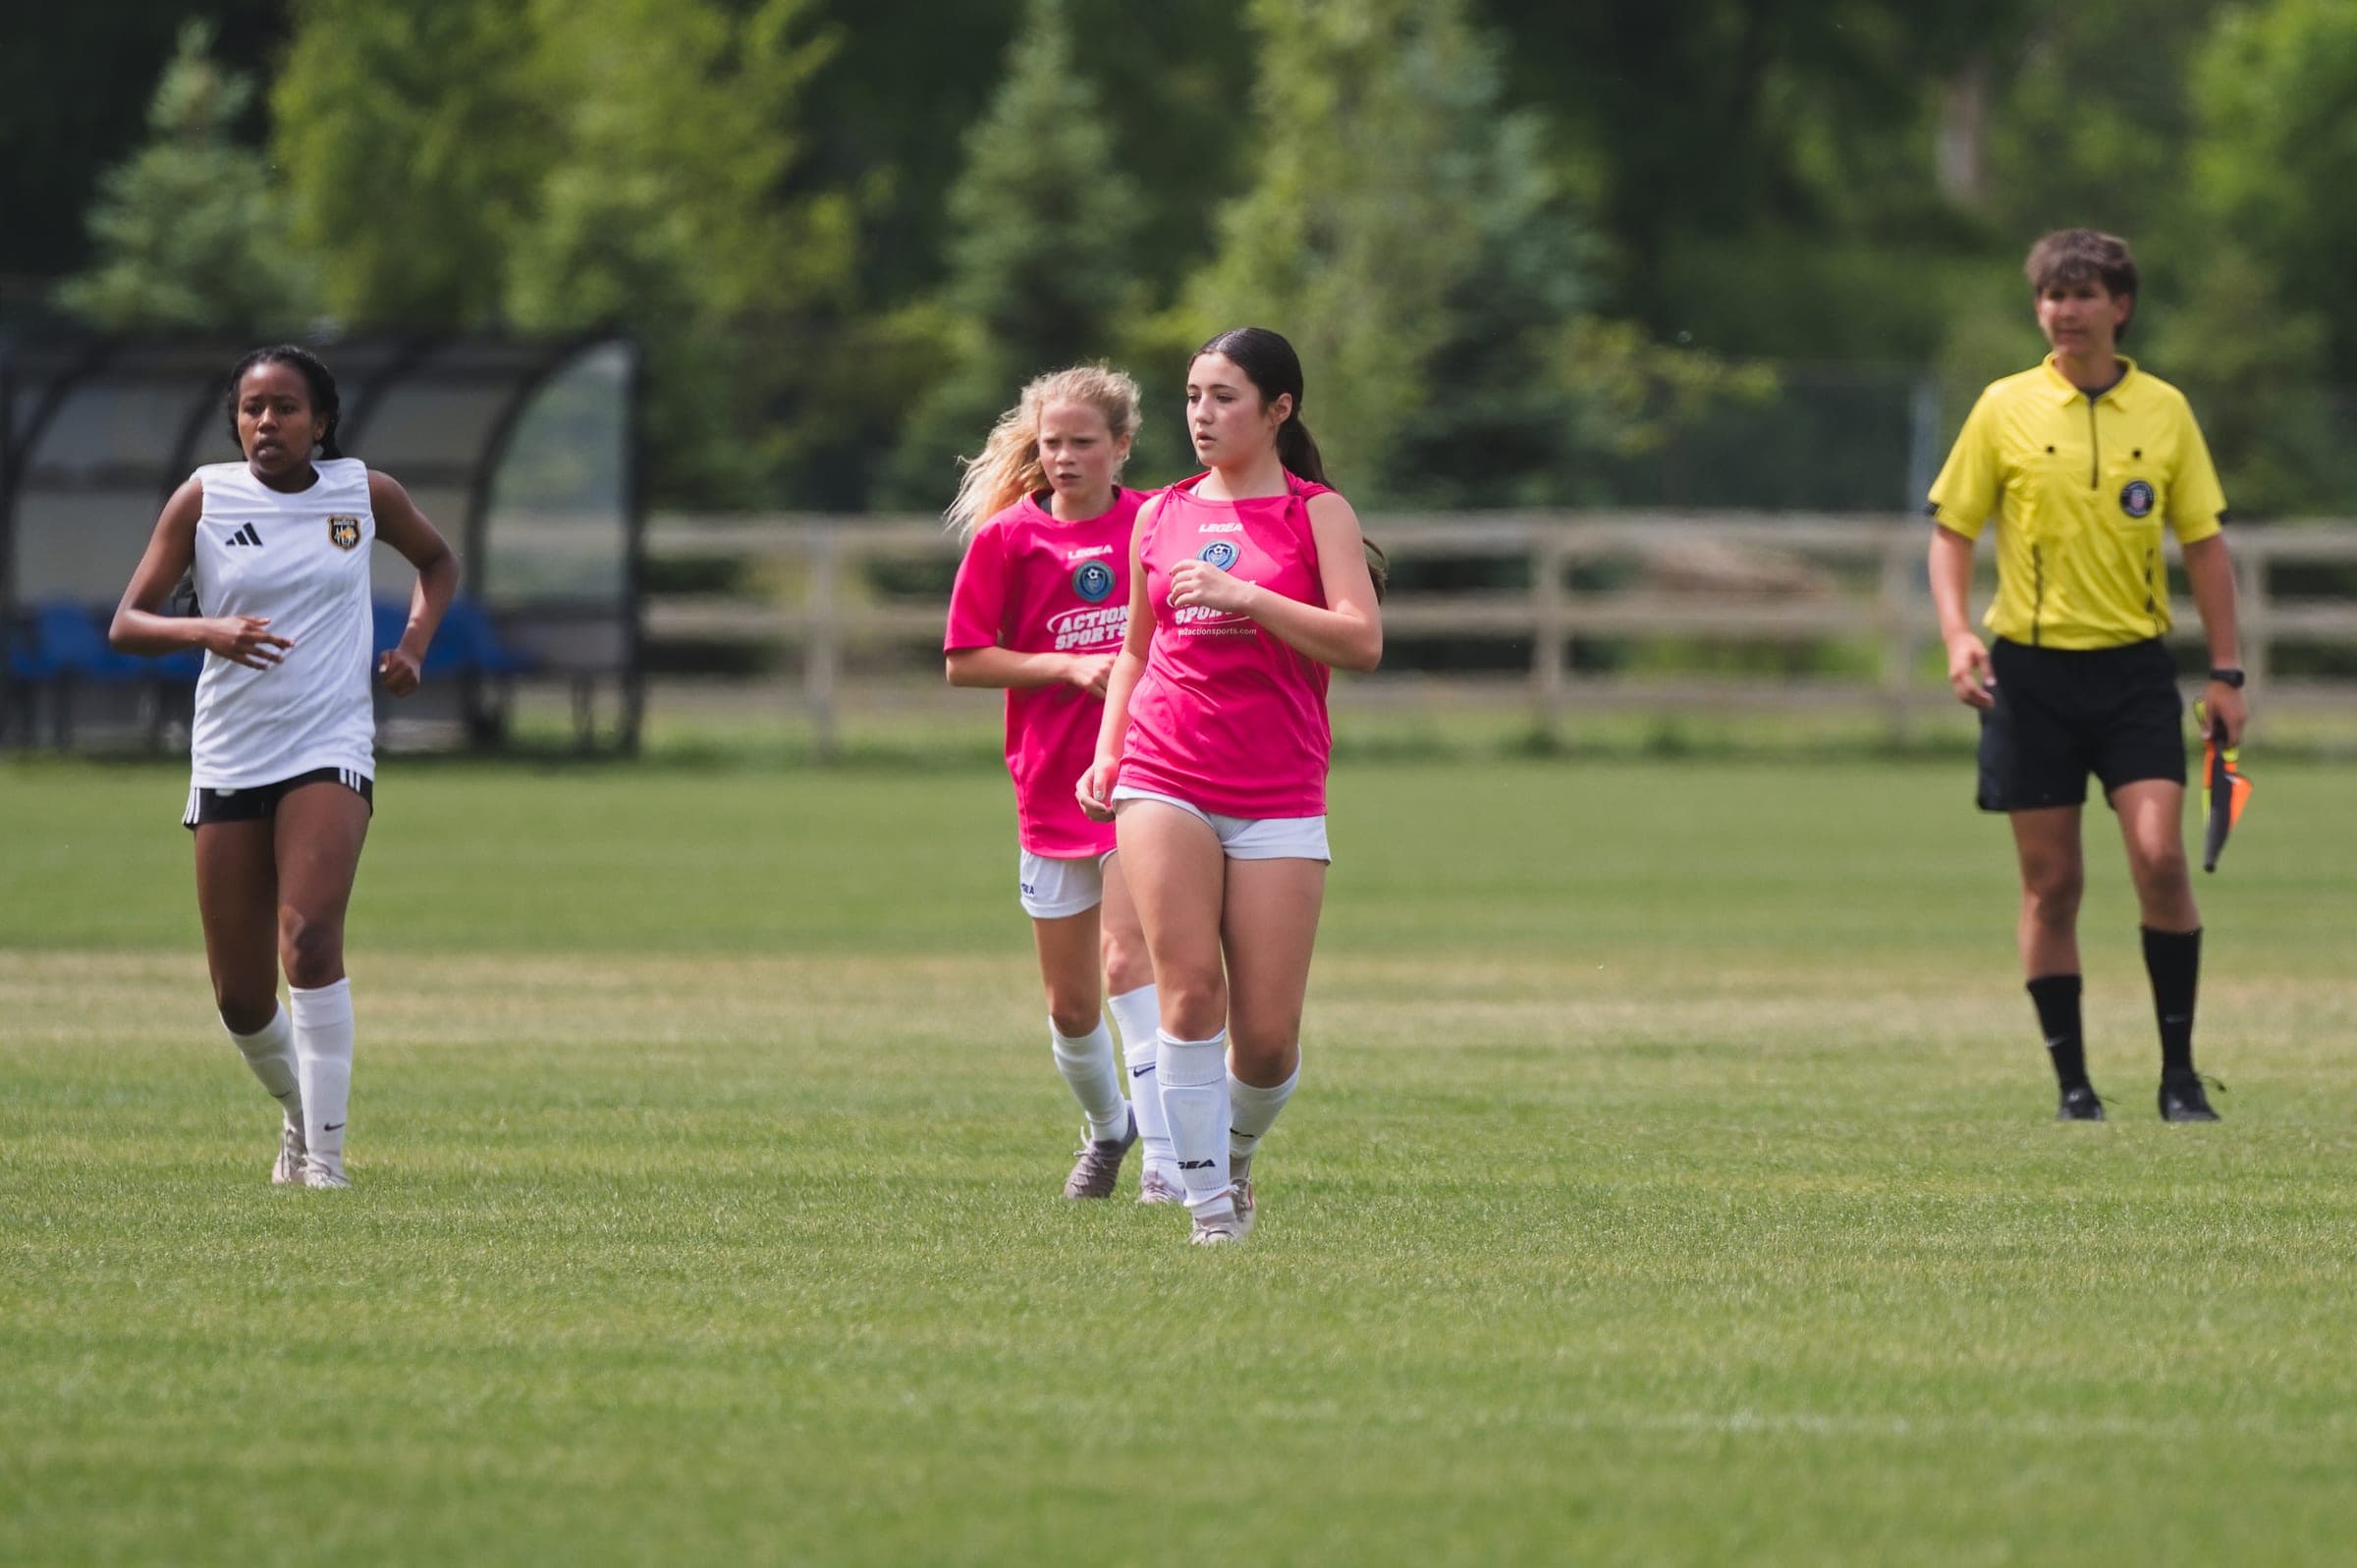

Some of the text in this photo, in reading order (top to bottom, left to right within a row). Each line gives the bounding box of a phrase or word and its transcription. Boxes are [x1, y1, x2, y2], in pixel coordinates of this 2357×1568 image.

[1198, 522, 1243, 533] LEGEA
[1058, 605, 1129, 635] ACTION
[1055, 621, 1127, 651] SPORTS
